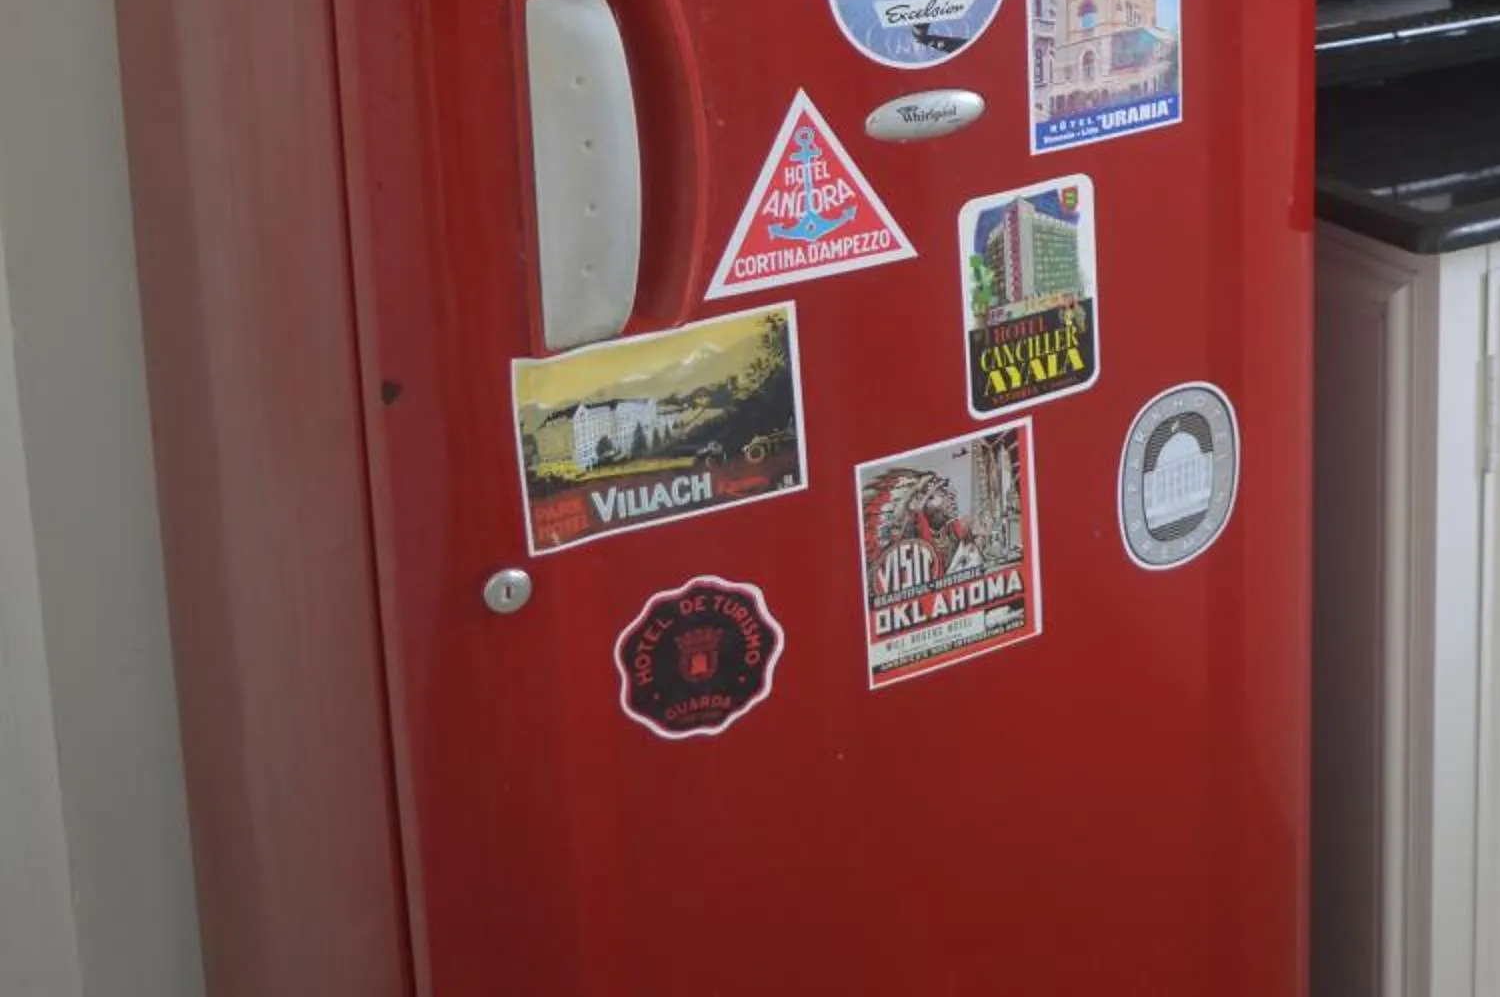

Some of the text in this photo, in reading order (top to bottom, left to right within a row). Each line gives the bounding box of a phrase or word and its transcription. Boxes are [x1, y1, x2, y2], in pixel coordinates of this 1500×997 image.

[901, 105, 957, 123] Whirlpool
[762, 178, 856, 219] ANCORA
[784, 162, 830, 187] HOTEL
[735, 230, 891, 278] CORTINA D'AMPEZZO
[981, 325, 1079, 371] CANCILLER
[994, 315, 1046, 343] HOTEL
[983, 347, 1085, 396] AYALA
[592, 473, 713, 523] VILLACH
[877, 544, 935, 594] VISIT
[875, 570, 1023, 636] OKLAHOMA
[634, 594, 761, 687] HOTEL DE TURISMO
